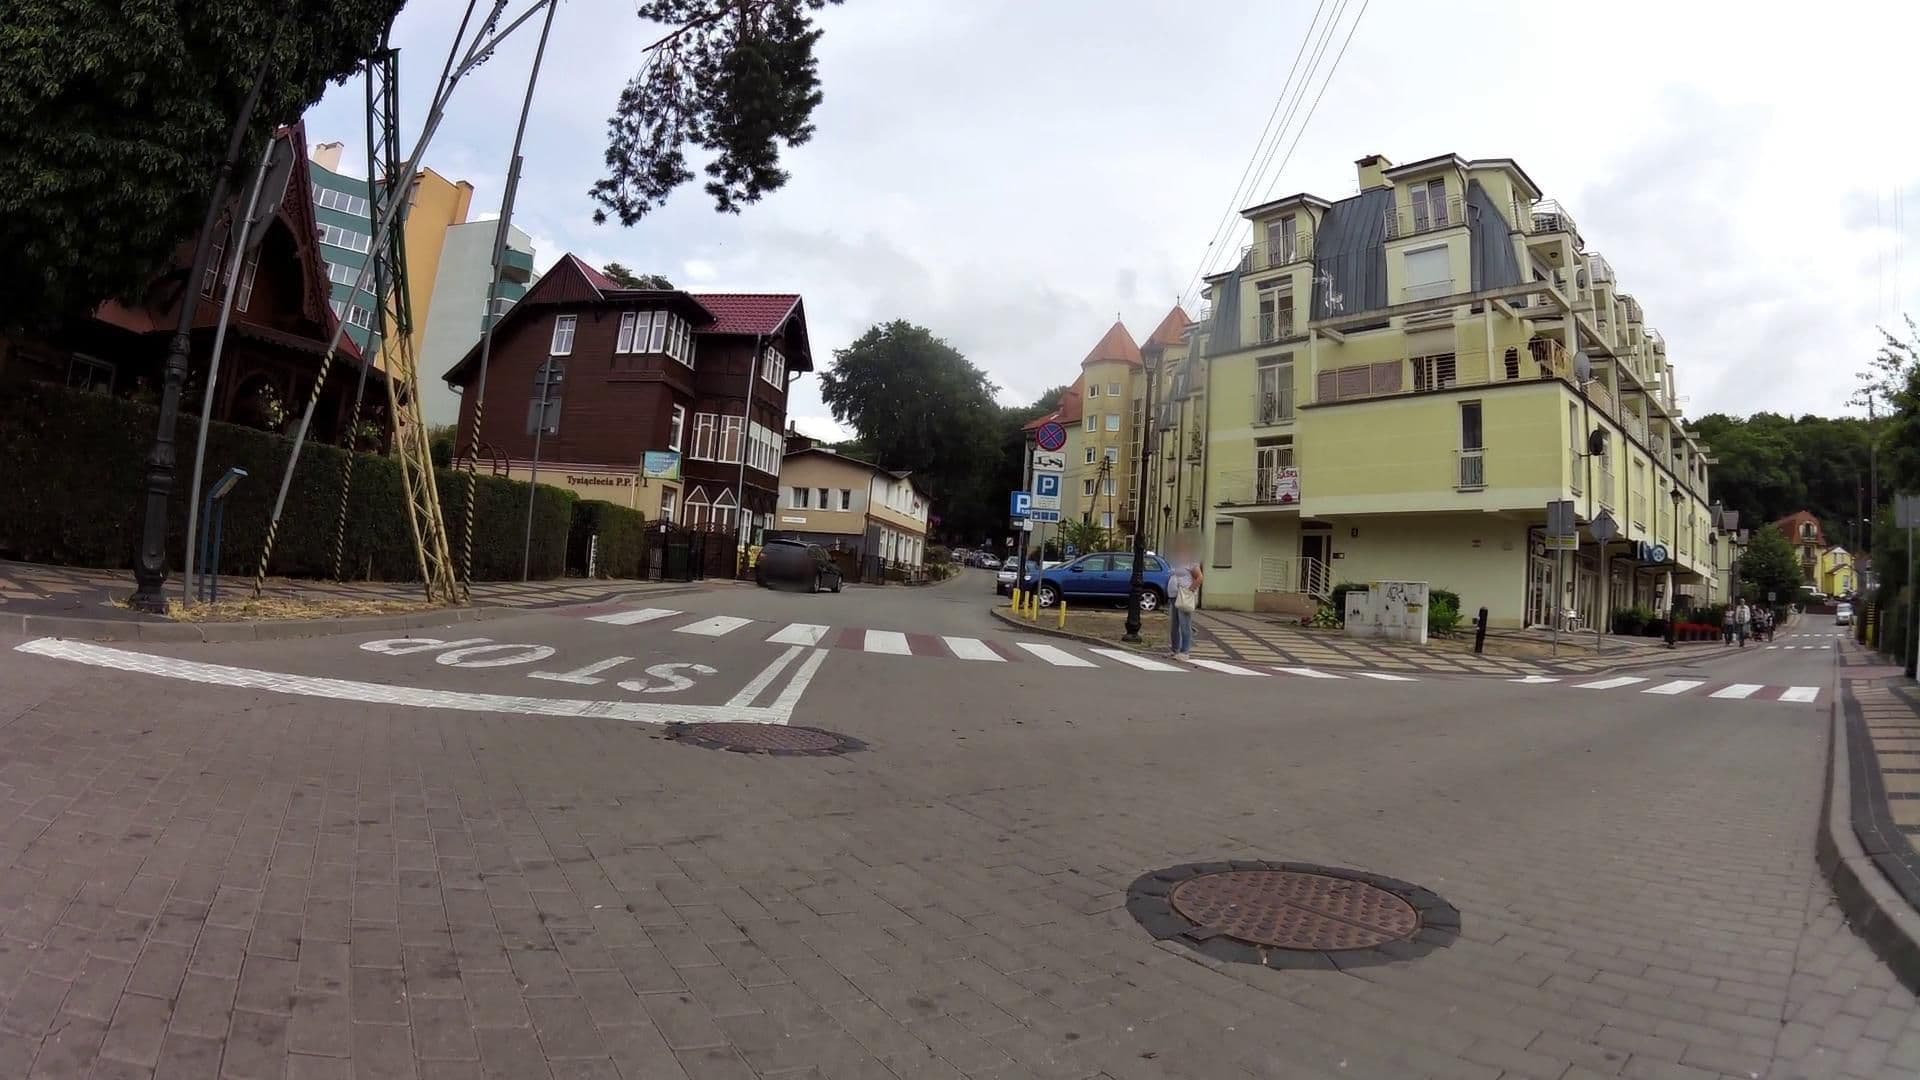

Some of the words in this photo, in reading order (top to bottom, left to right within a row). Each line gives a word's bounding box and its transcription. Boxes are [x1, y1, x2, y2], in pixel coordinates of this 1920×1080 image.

[1042, 477, 1054, 493] P
[1016, 494, 1031, 513] P
[359, 637, 718, 693] STOP
